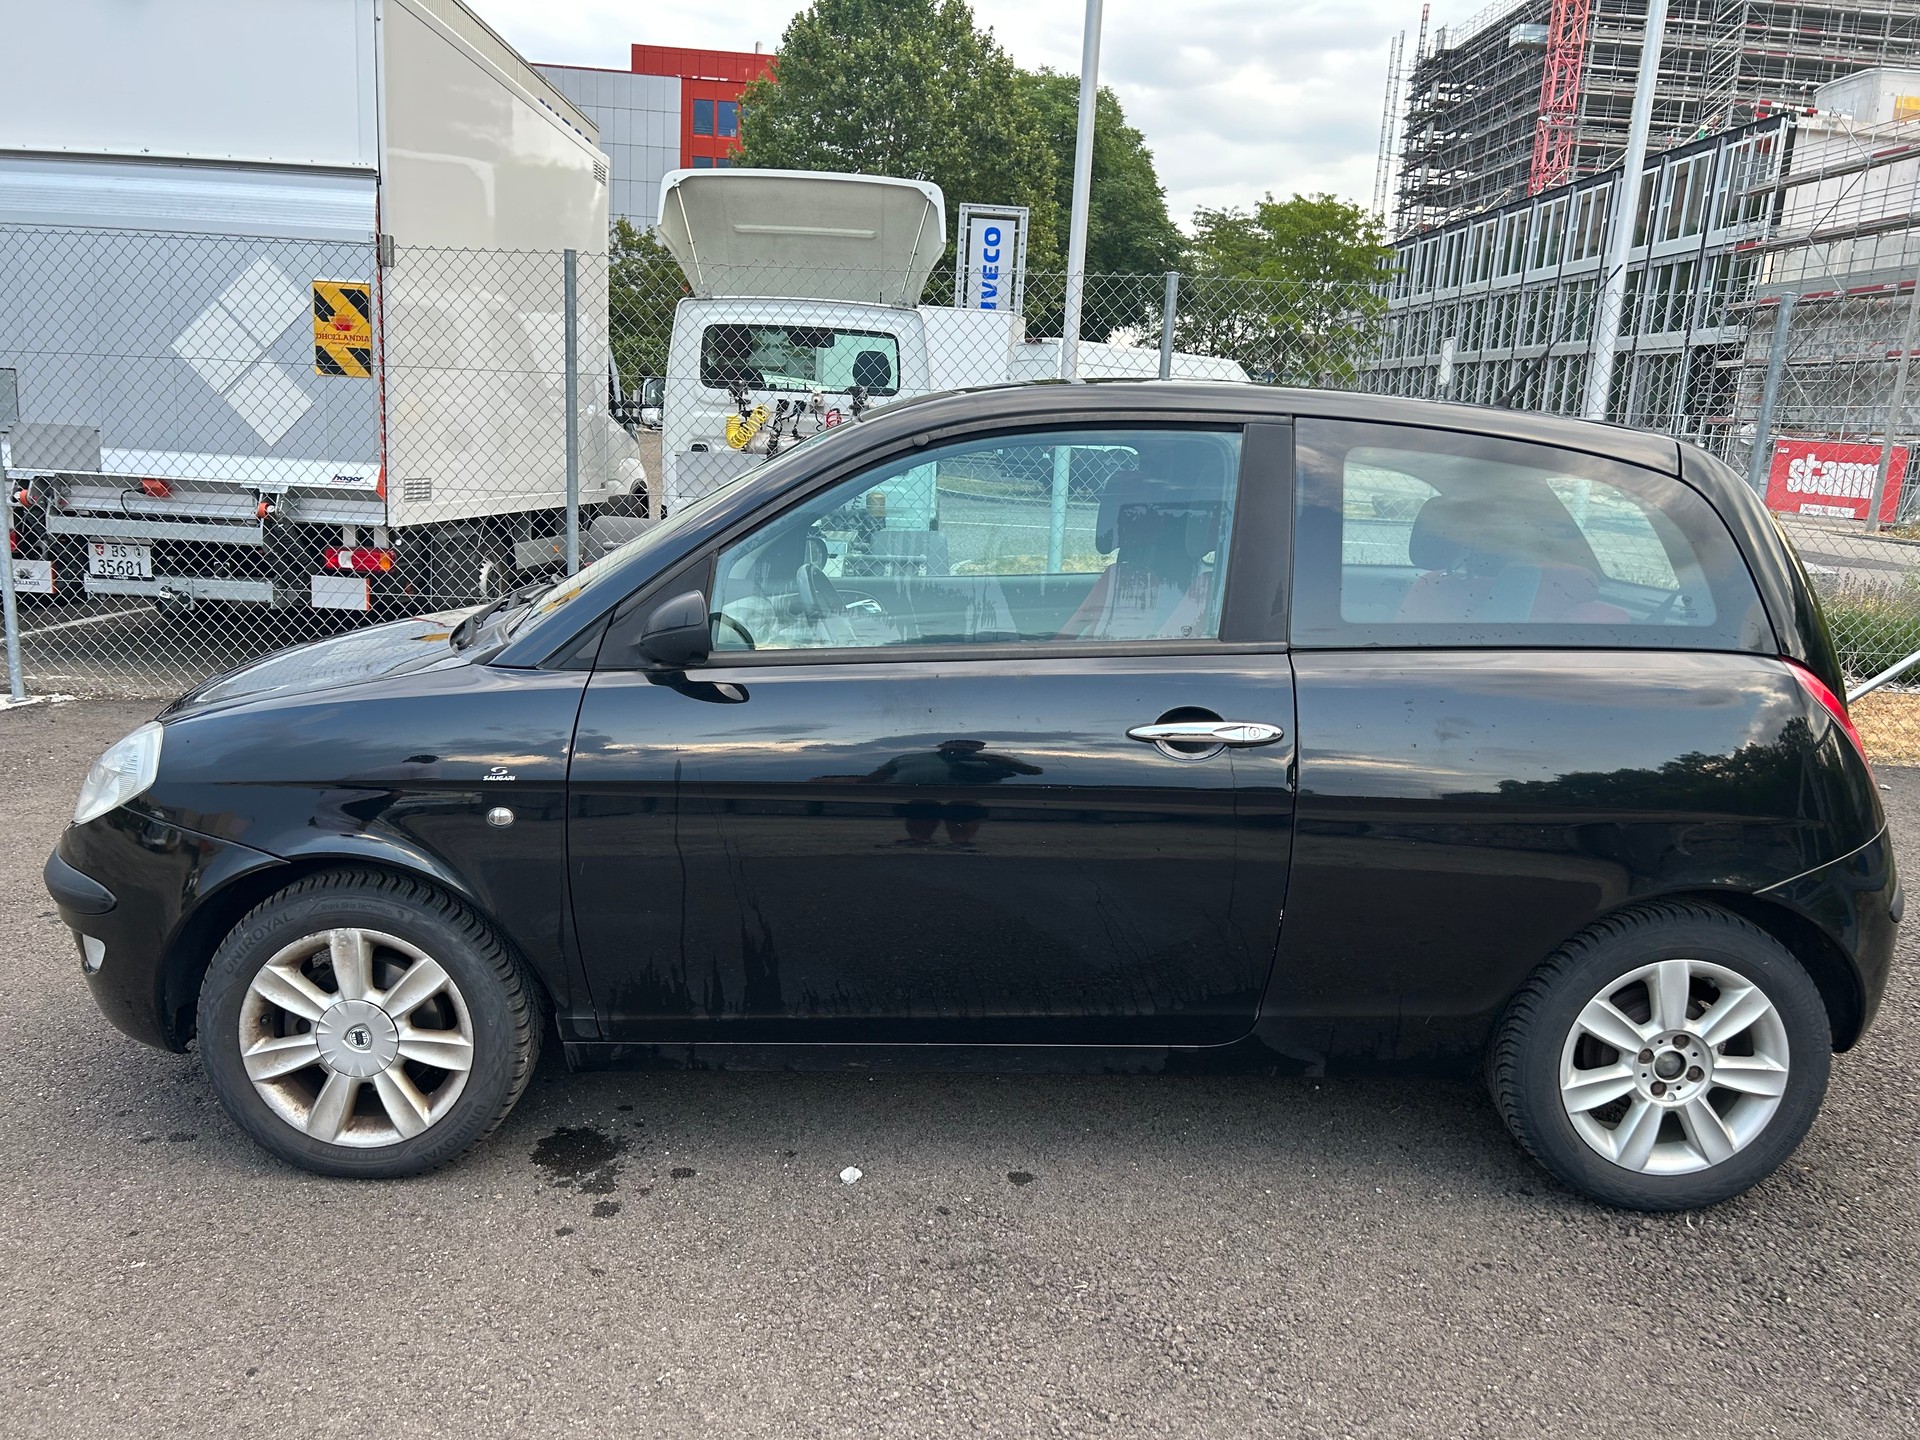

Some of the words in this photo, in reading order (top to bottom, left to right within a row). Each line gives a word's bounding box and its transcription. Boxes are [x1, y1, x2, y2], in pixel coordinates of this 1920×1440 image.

[980, 226, 1002, 310] IVECO
[315, 332, 370, 342] DHOLLANDIA
[98, 559, 143, 577] 35681
[111, 545, 127, 557] BS
[224, 911, 295, 975] UNIROYAL
[419, 1104, 488, 1163] UNIROYAL
